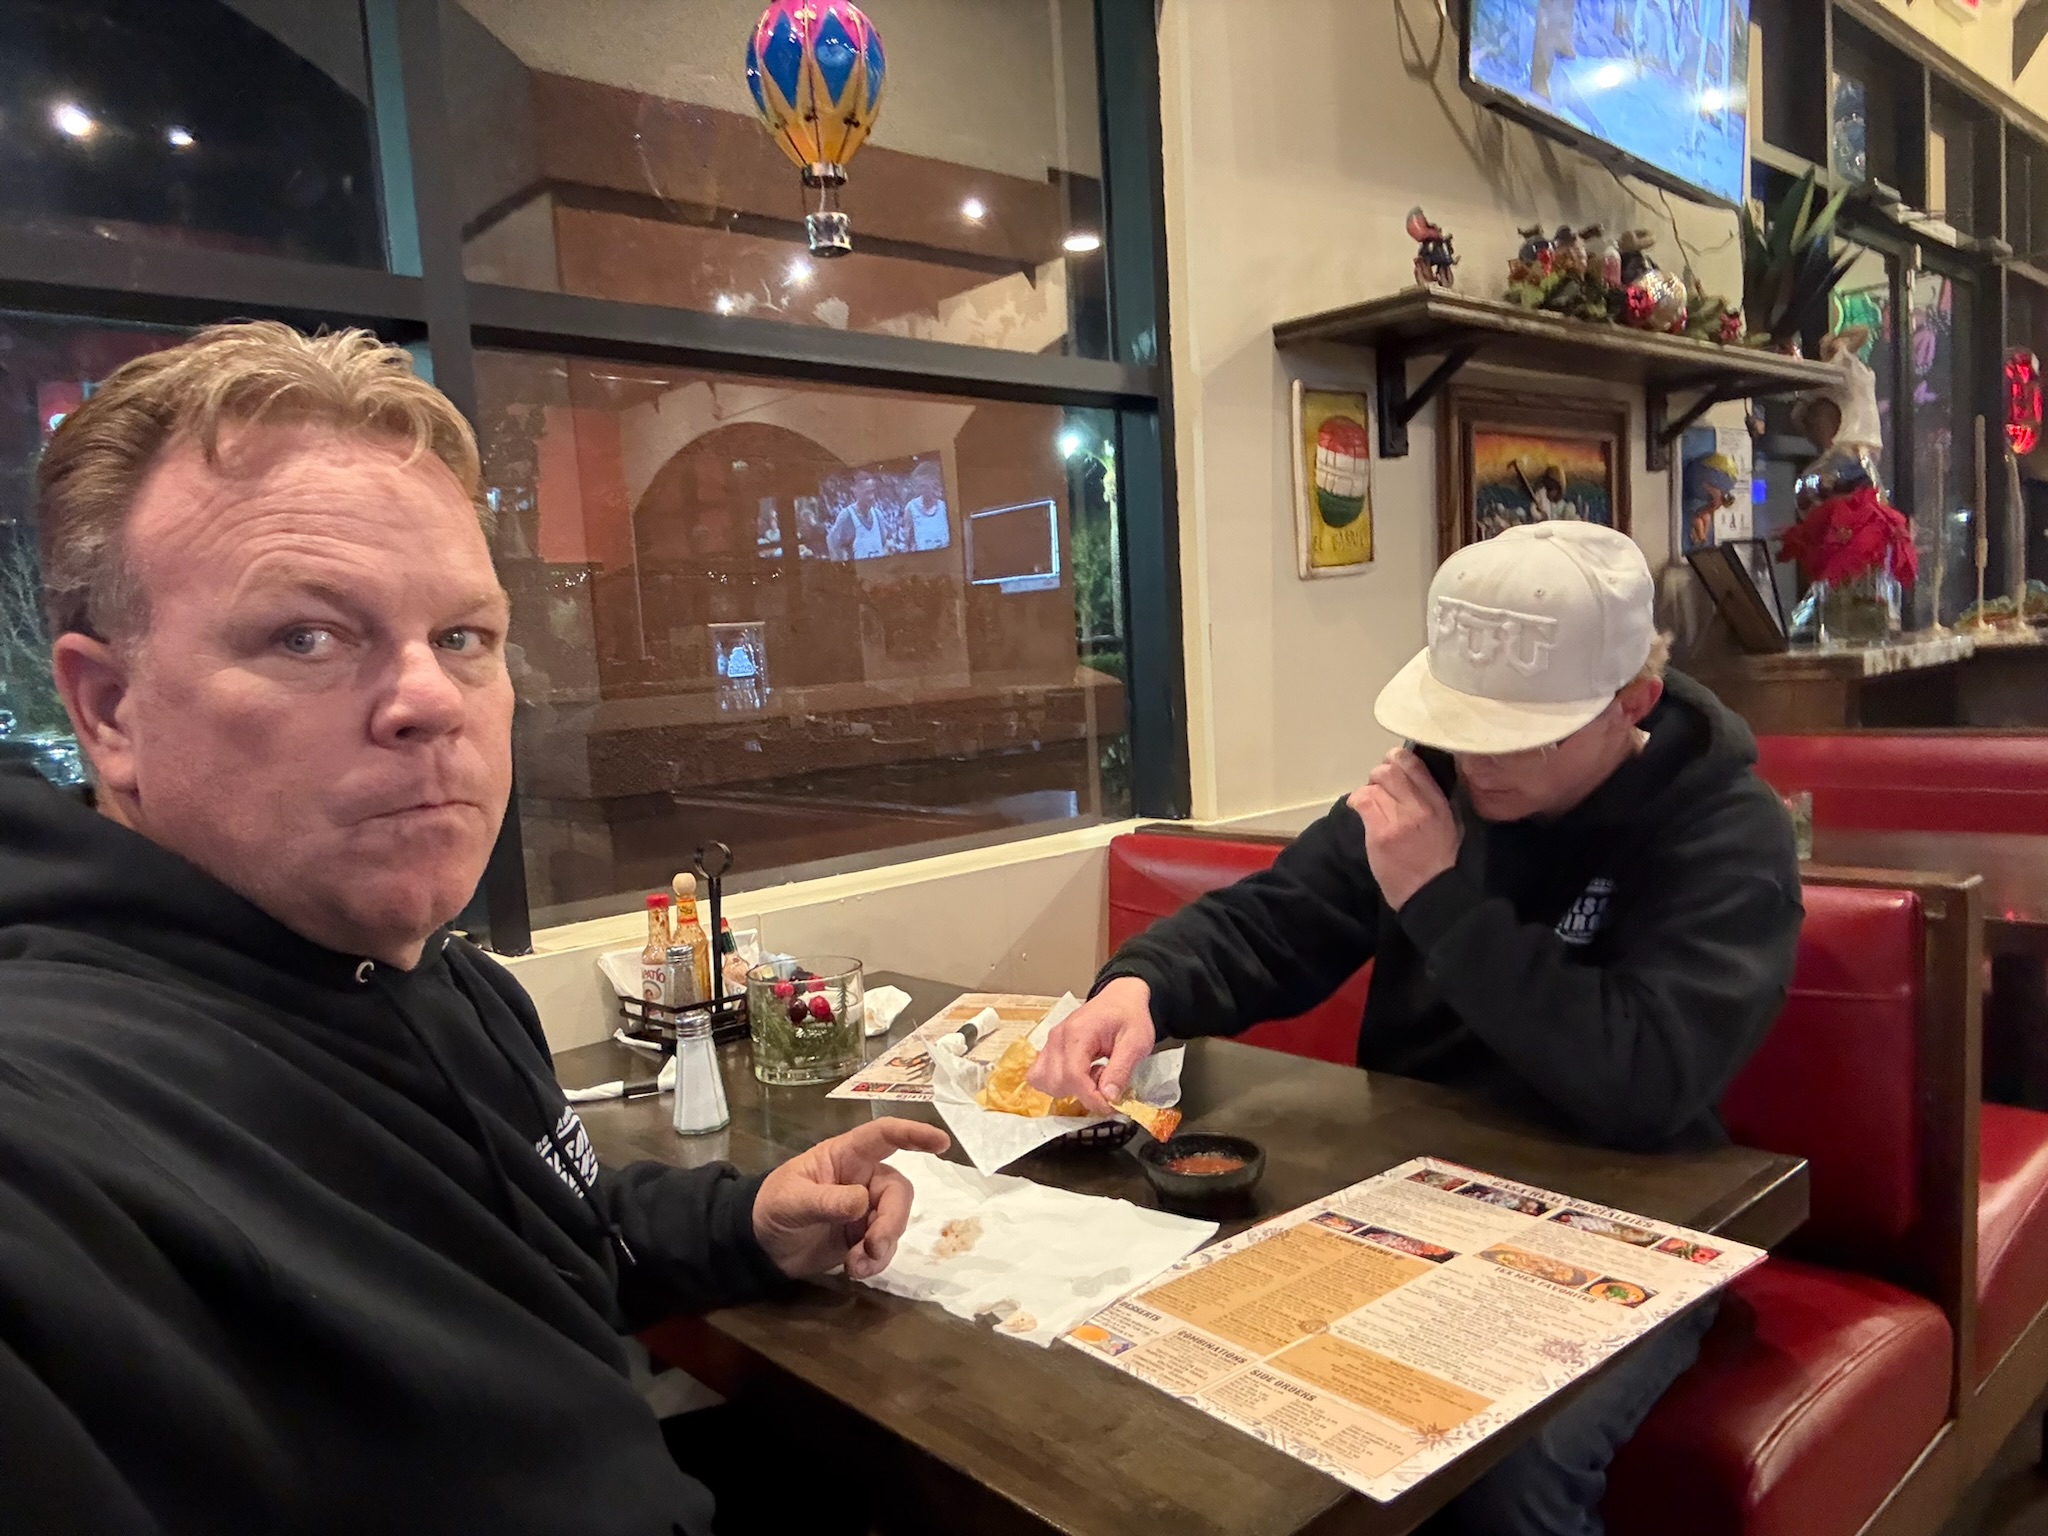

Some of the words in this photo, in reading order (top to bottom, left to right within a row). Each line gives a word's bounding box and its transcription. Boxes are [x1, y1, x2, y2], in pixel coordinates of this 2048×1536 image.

[1537, 1281, 1598, 1303] FAVORITES
[1119, 1301, 1162, 1321] DESSERTS
[1177, 1330, 1248, 1363] COMBINATIONS
[1249, 1368, 1277, 1382] SIDE
[1273, 1379, 1318, 1401] ORDERS
